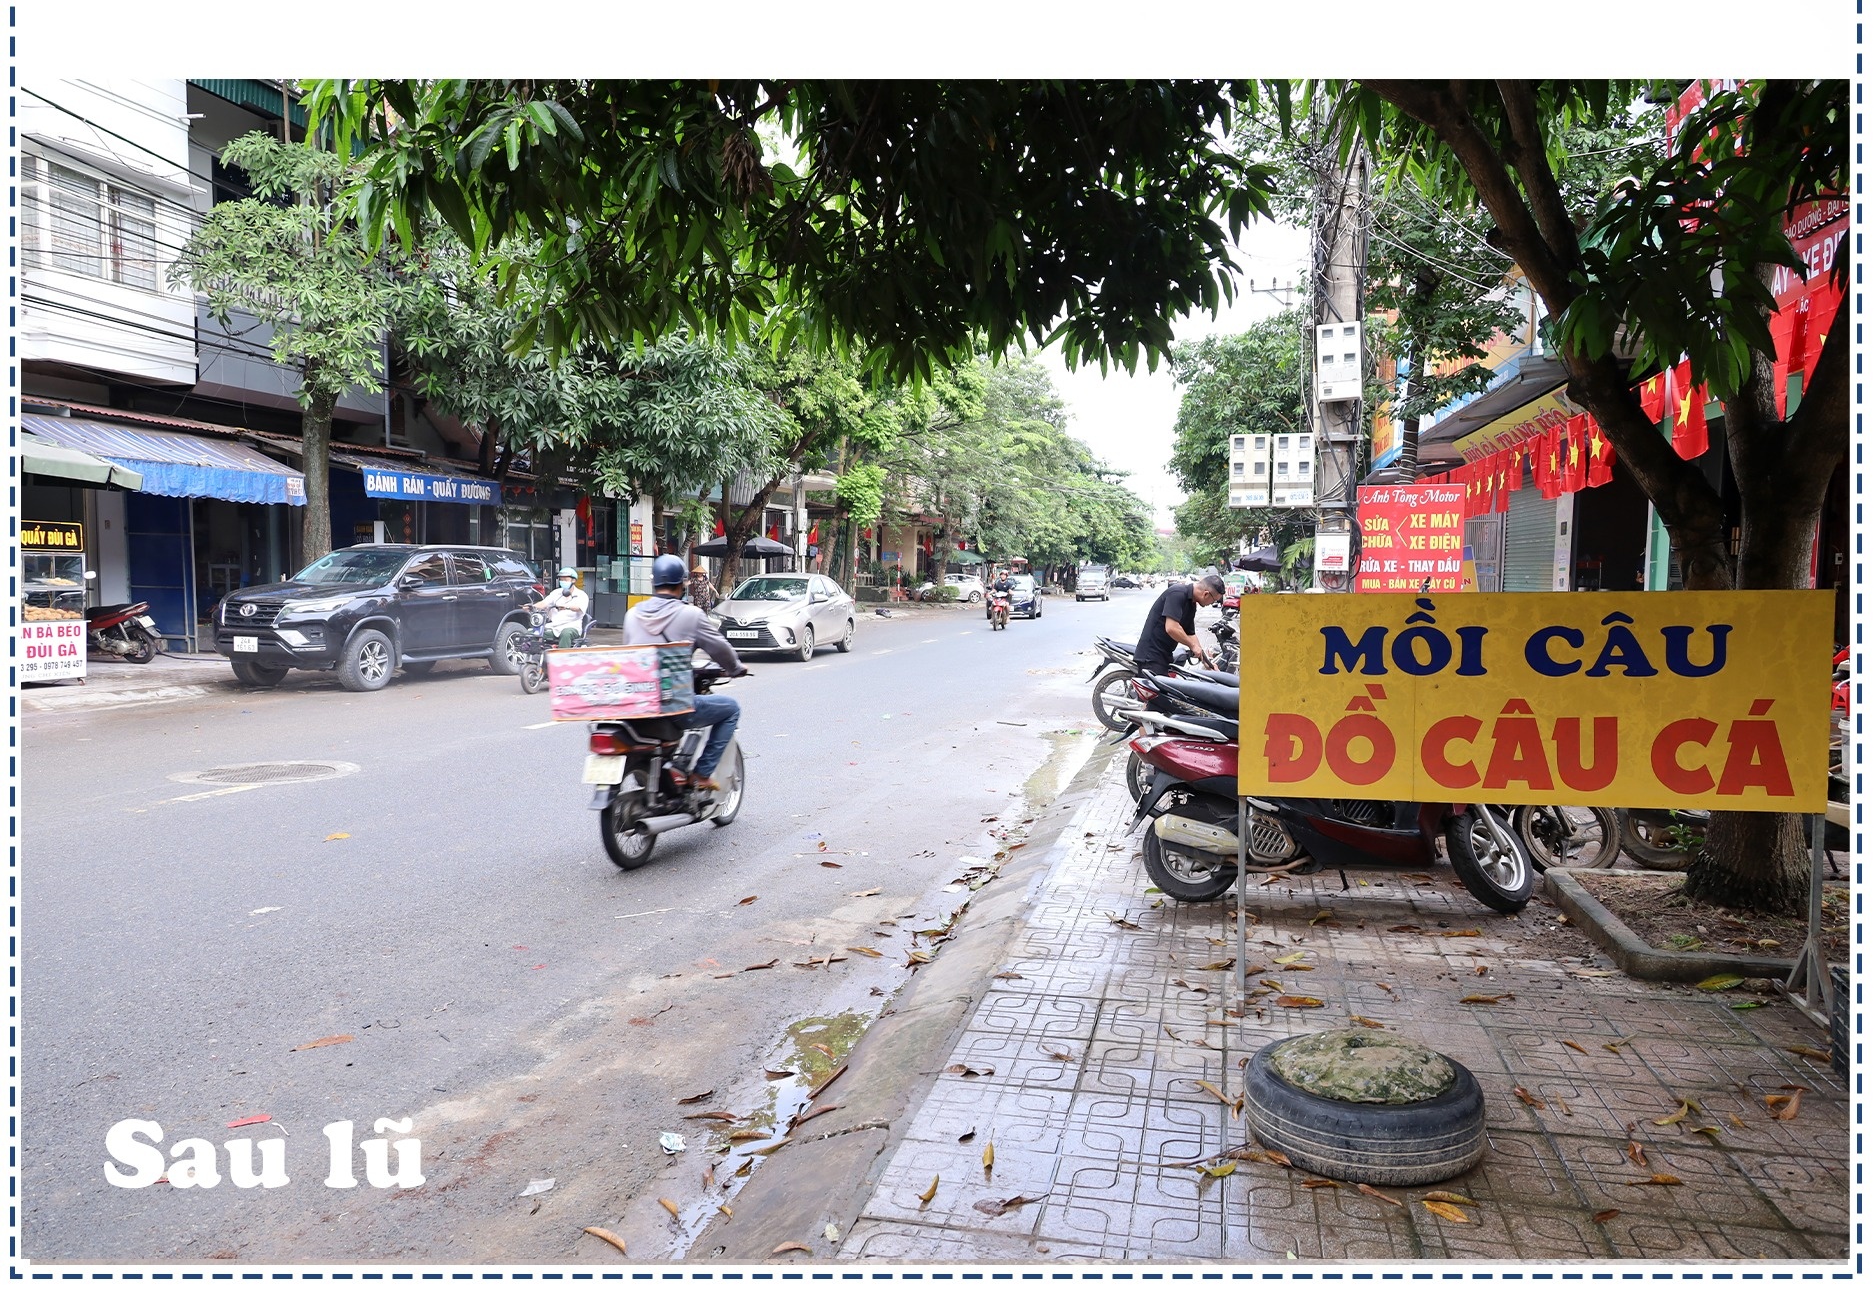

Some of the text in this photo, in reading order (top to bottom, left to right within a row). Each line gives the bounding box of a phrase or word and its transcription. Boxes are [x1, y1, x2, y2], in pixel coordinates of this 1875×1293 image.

[367, 472, 397, 493] BÁNH
[403, 475, 424, 495] RÁN
[432, 478, 457, 498] QUẨY
[461, 481, 491, 500] ĐƯỜNG
[1420, 489, 1460, 504] Motor
[1364, 514, 1389, 531] SỬA
[1410, 510, 1459, 528] XE MÁY
[21, 525, 78, 546] QUẨY ĐÙI GÀ
[1361, 533, 1393, 549] CHỮA
[1409, 533, 1460, 553] XE ĐIỆN
[1359, 556, 1381, 572] RỬA
[1383, 560, 1398, 572] XE
[1408, 560, 1435, 572] THAY
[1437, 555, 1460, 573] DẦU
[1361, 578, 1381, 589] MUA
[1388, 576, 1406, 589] BÁN
[1409, 578, 1420, 589] XE
[1443, 576, 1455, 589] CŨ
[36, 624, 53, 639] BÀ
[57, 623, 81, 638] BÉO
[1318, 598, 1733, 677] MỒI CÂU
[26, 641, 77, 658] ĐÙI GÀ
[1264, 683, 1796, 797] ĐỒ CÂU CÁ
